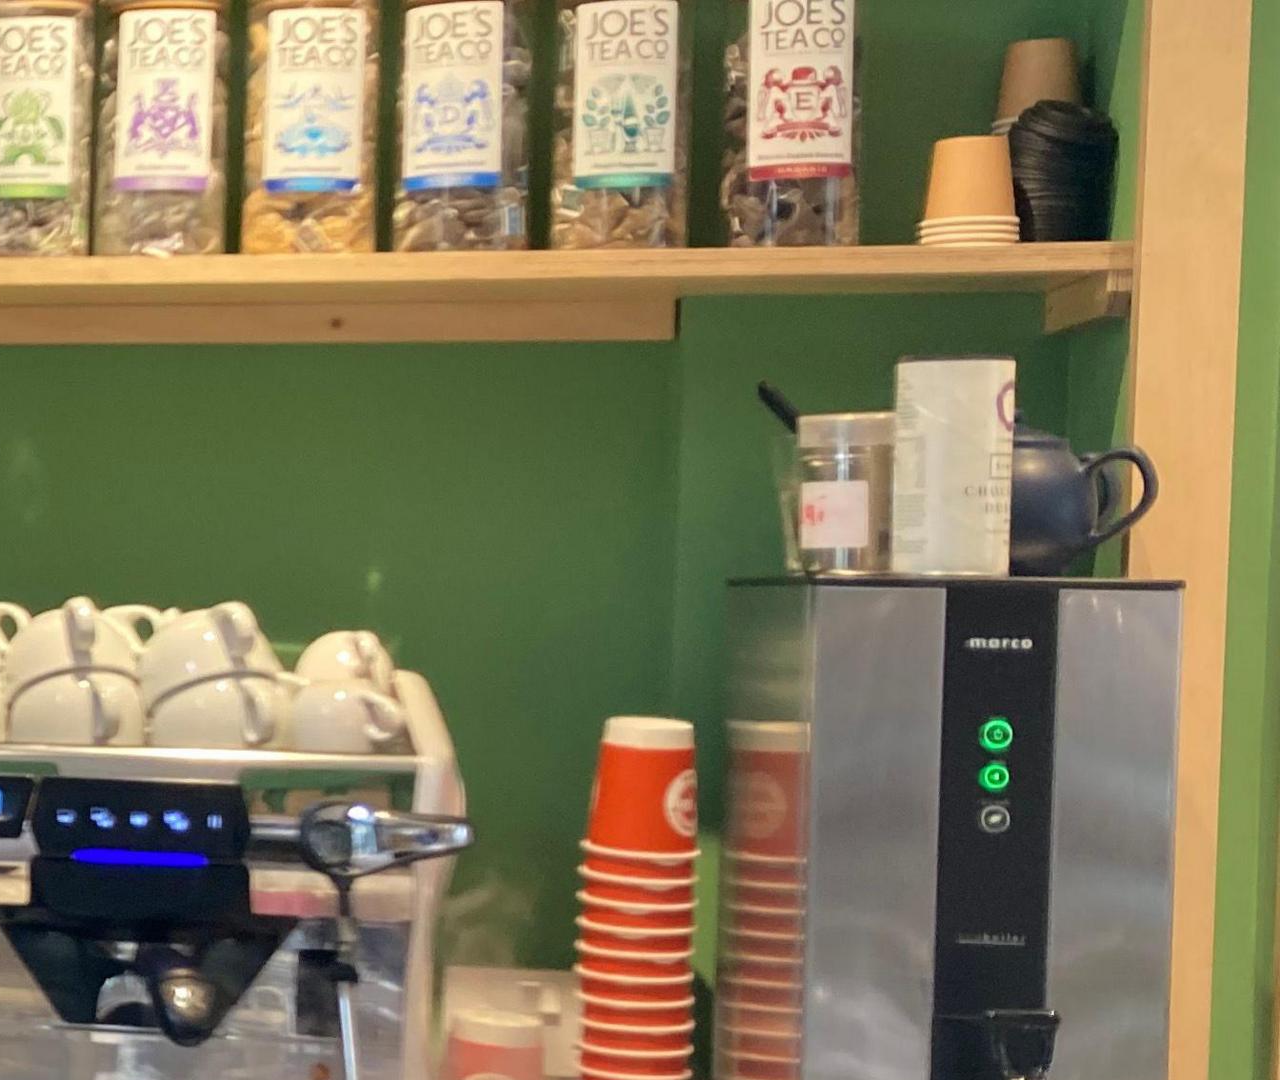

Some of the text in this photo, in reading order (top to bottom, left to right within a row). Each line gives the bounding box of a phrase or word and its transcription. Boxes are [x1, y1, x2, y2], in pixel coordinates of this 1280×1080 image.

[585, 4, 669, 40] JOE'S
[761, 29, 808, 50] TEA
[795, 91, 814, 111] E
[968, 637, 1033, 650] marco
